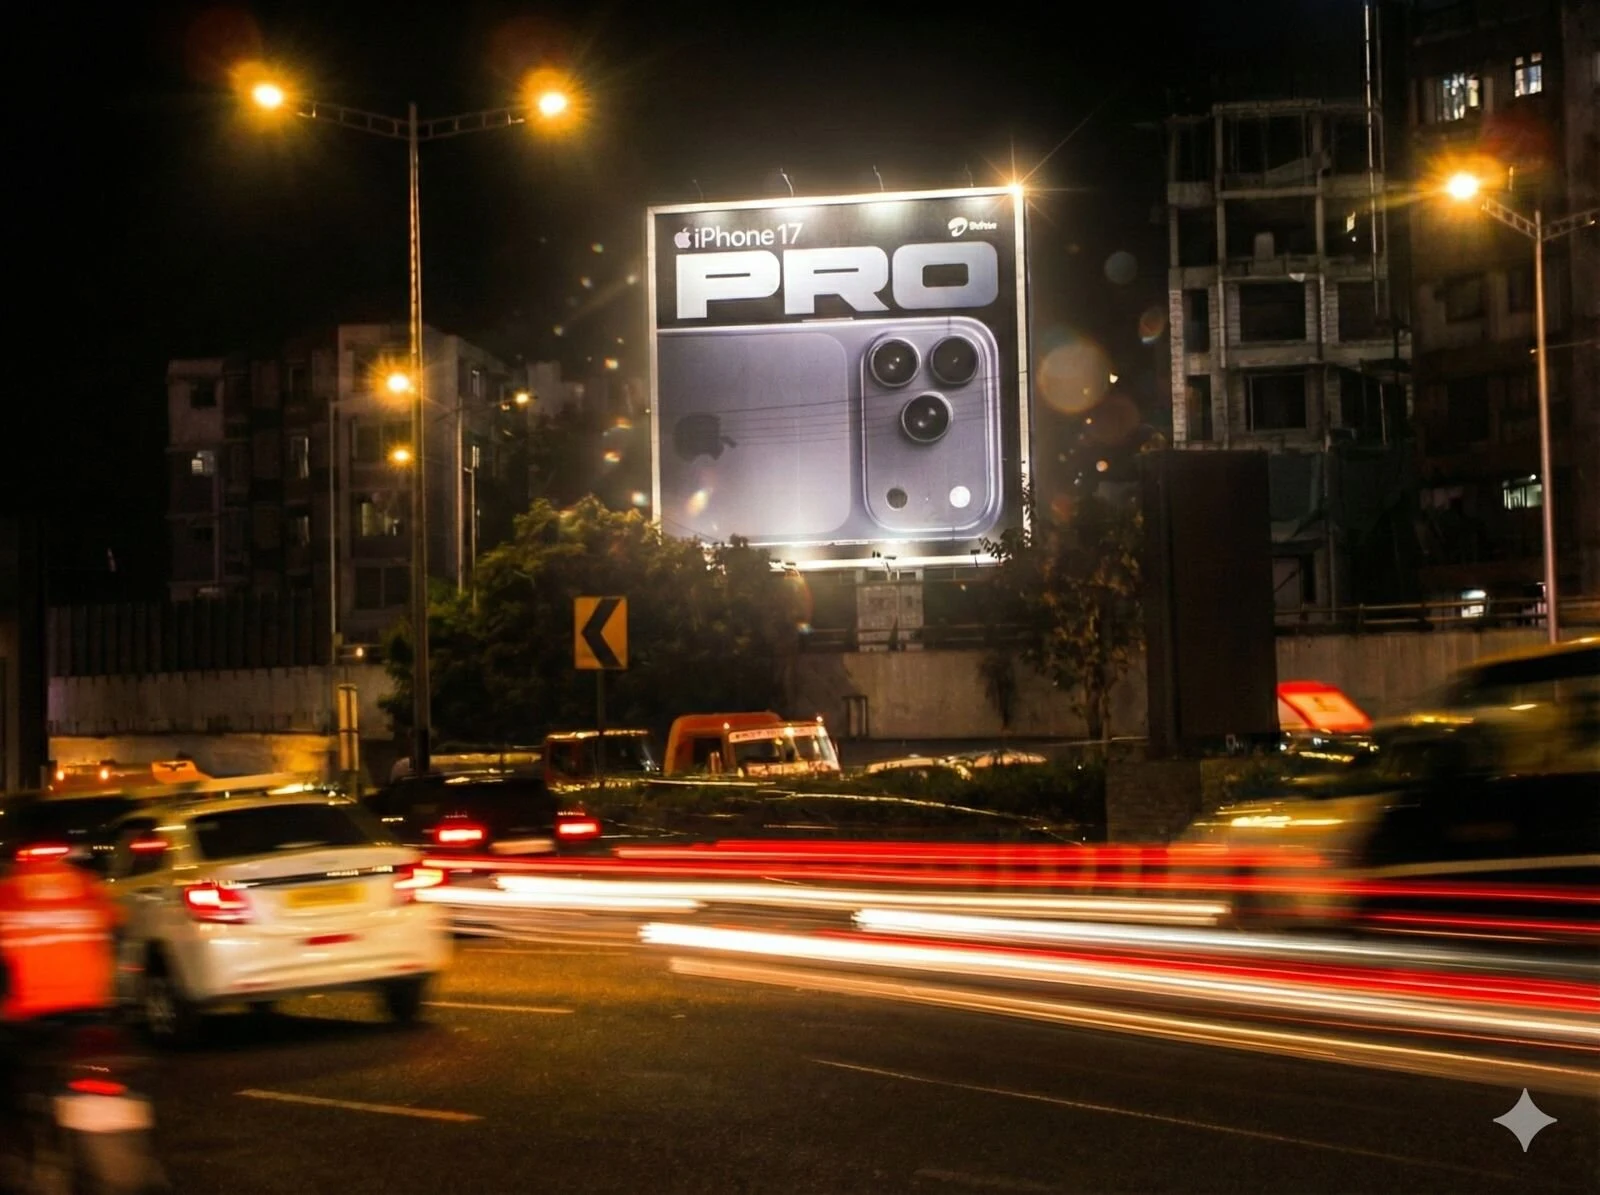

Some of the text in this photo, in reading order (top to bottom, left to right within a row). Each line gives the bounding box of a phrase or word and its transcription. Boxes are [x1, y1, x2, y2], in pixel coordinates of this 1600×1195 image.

[694, 223, 804, 248] iPhone 17
[676, 241, 998, 319] PRO
